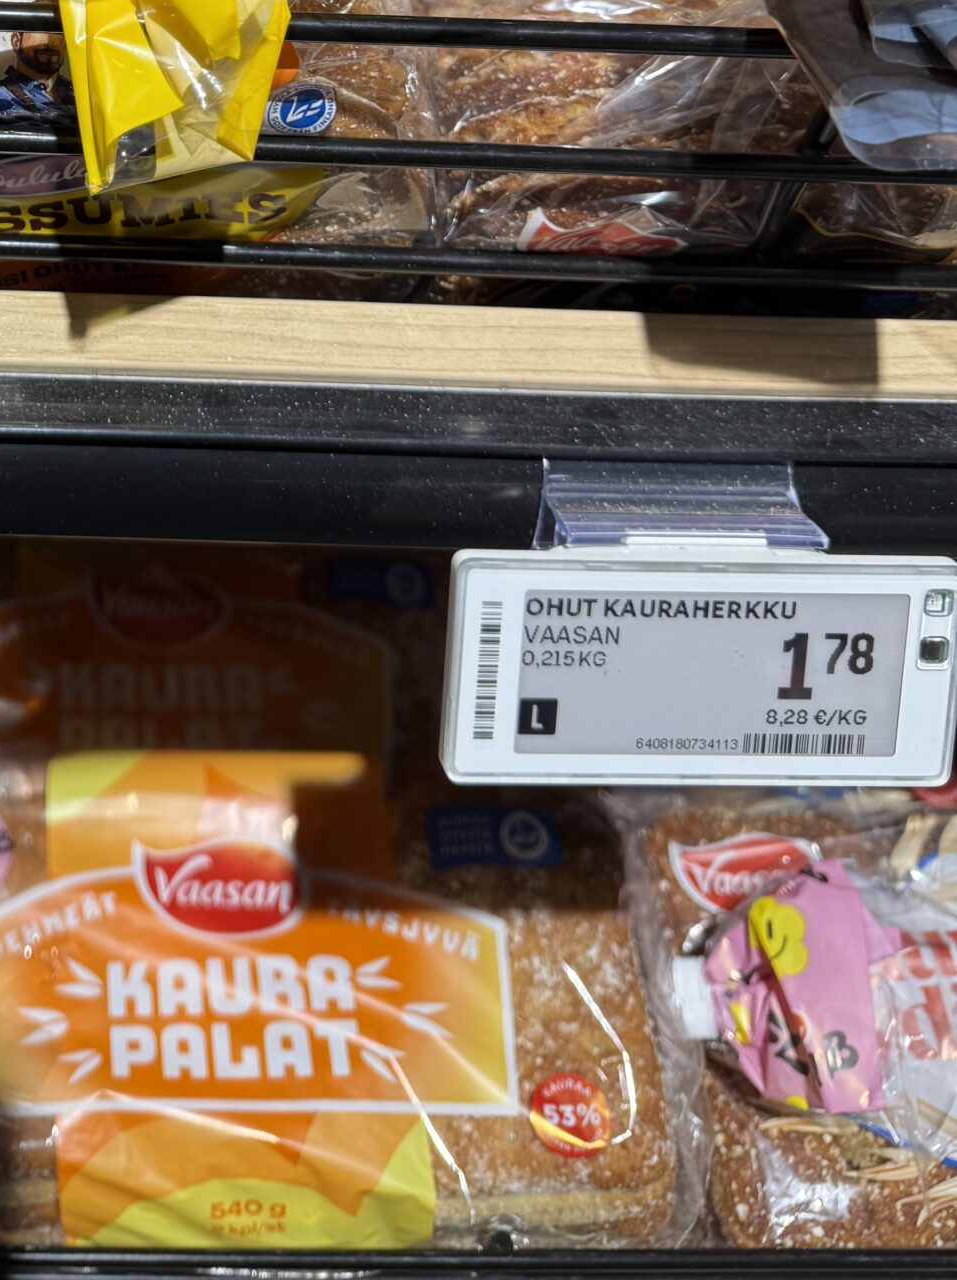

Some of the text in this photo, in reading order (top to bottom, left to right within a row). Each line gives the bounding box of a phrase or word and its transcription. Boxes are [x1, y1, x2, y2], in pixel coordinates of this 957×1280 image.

[526, 597, 797, 620] OHUT KAURAHERKKU
[524, 625, 620, 645] VAASAN
[522, 650, 606, 668] 0,215 KG
[777, 632, 874, 700] 1 78
[765, 709, 867, 727] 8,28 €/KG
[636, 737, 739, 751] 6408180734113
[154, 852, 293, 914] Vaasan
[105, 954, 355, 1018] KAURA
[109, 1018, 360, 1081] PALAT
[543, 1103, 601, 1128] 53%
[210, 1199, 287, 1220] 540 g
